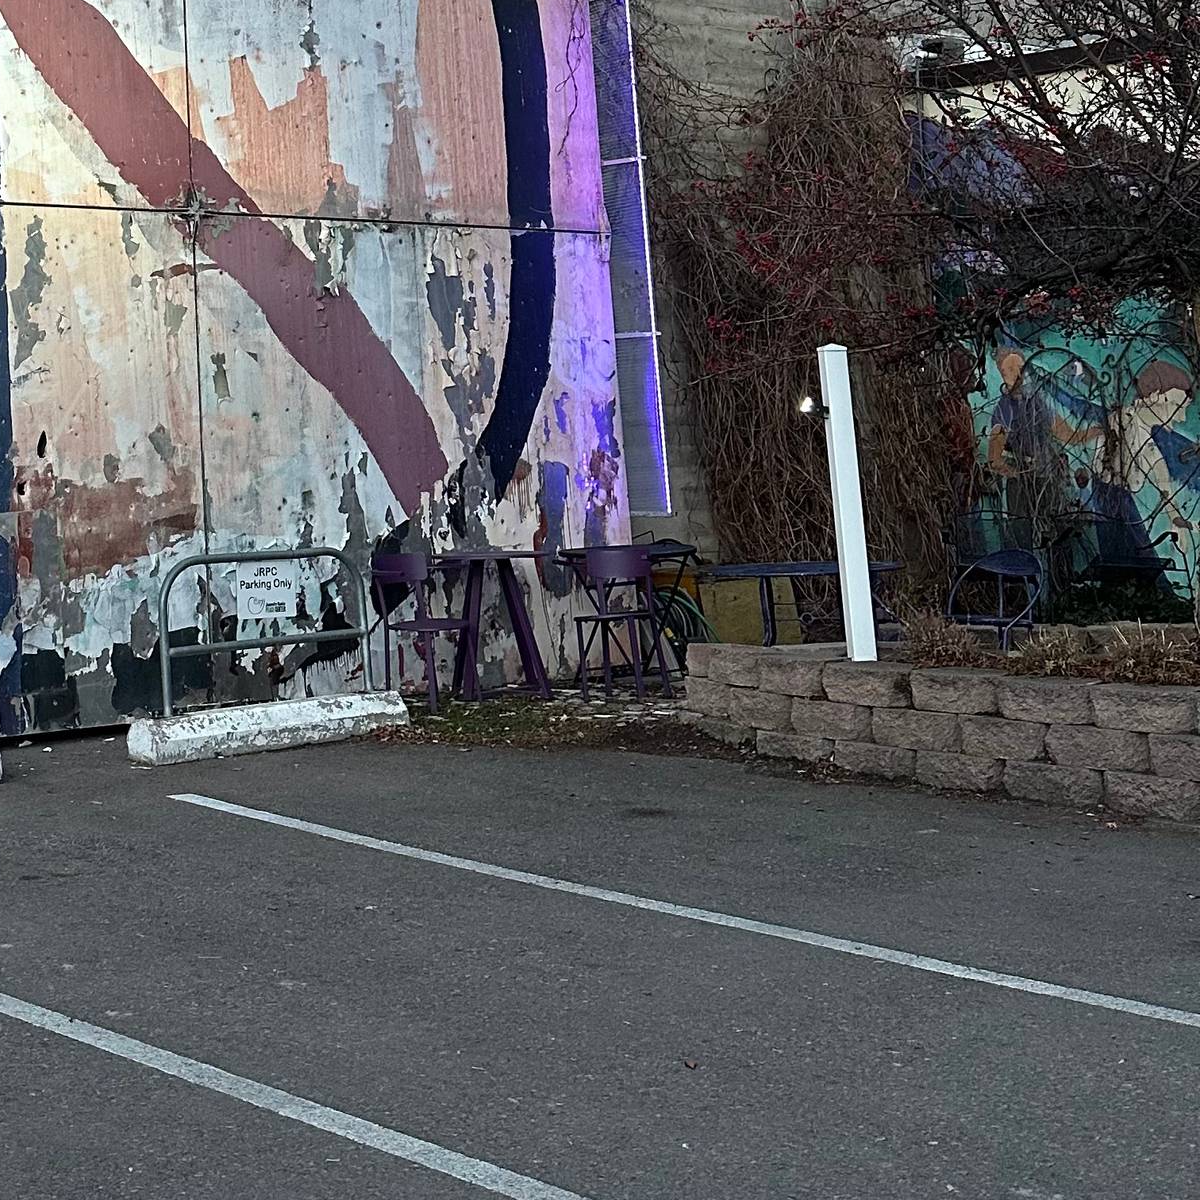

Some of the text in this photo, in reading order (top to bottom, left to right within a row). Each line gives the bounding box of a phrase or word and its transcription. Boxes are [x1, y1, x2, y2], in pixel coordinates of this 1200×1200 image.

[253, 566, 278, 577] JRPC
[240, 578, 293, 591] Parking Only
